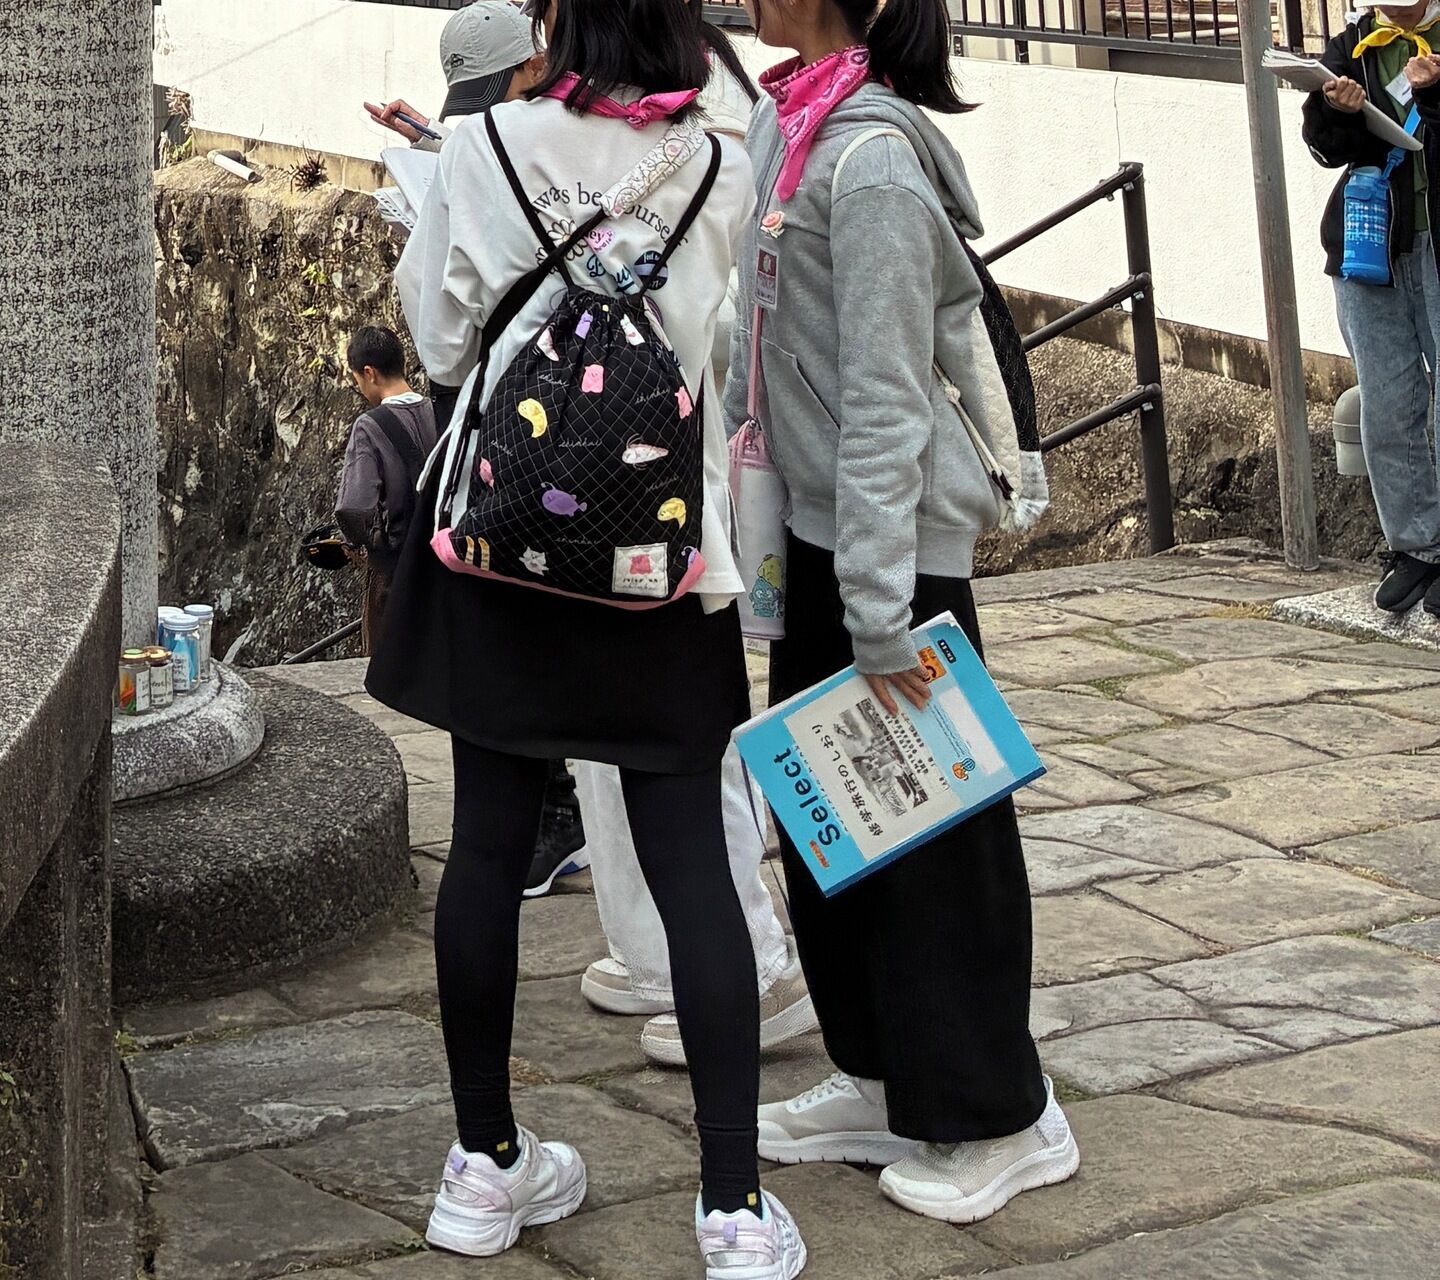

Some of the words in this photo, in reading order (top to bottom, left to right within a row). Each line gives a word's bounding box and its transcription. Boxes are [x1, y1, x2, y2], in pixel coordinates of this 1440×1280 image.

[773, 747, 841, 846] Select
[811, 724, 884, 837] 修学旅行のしおり
